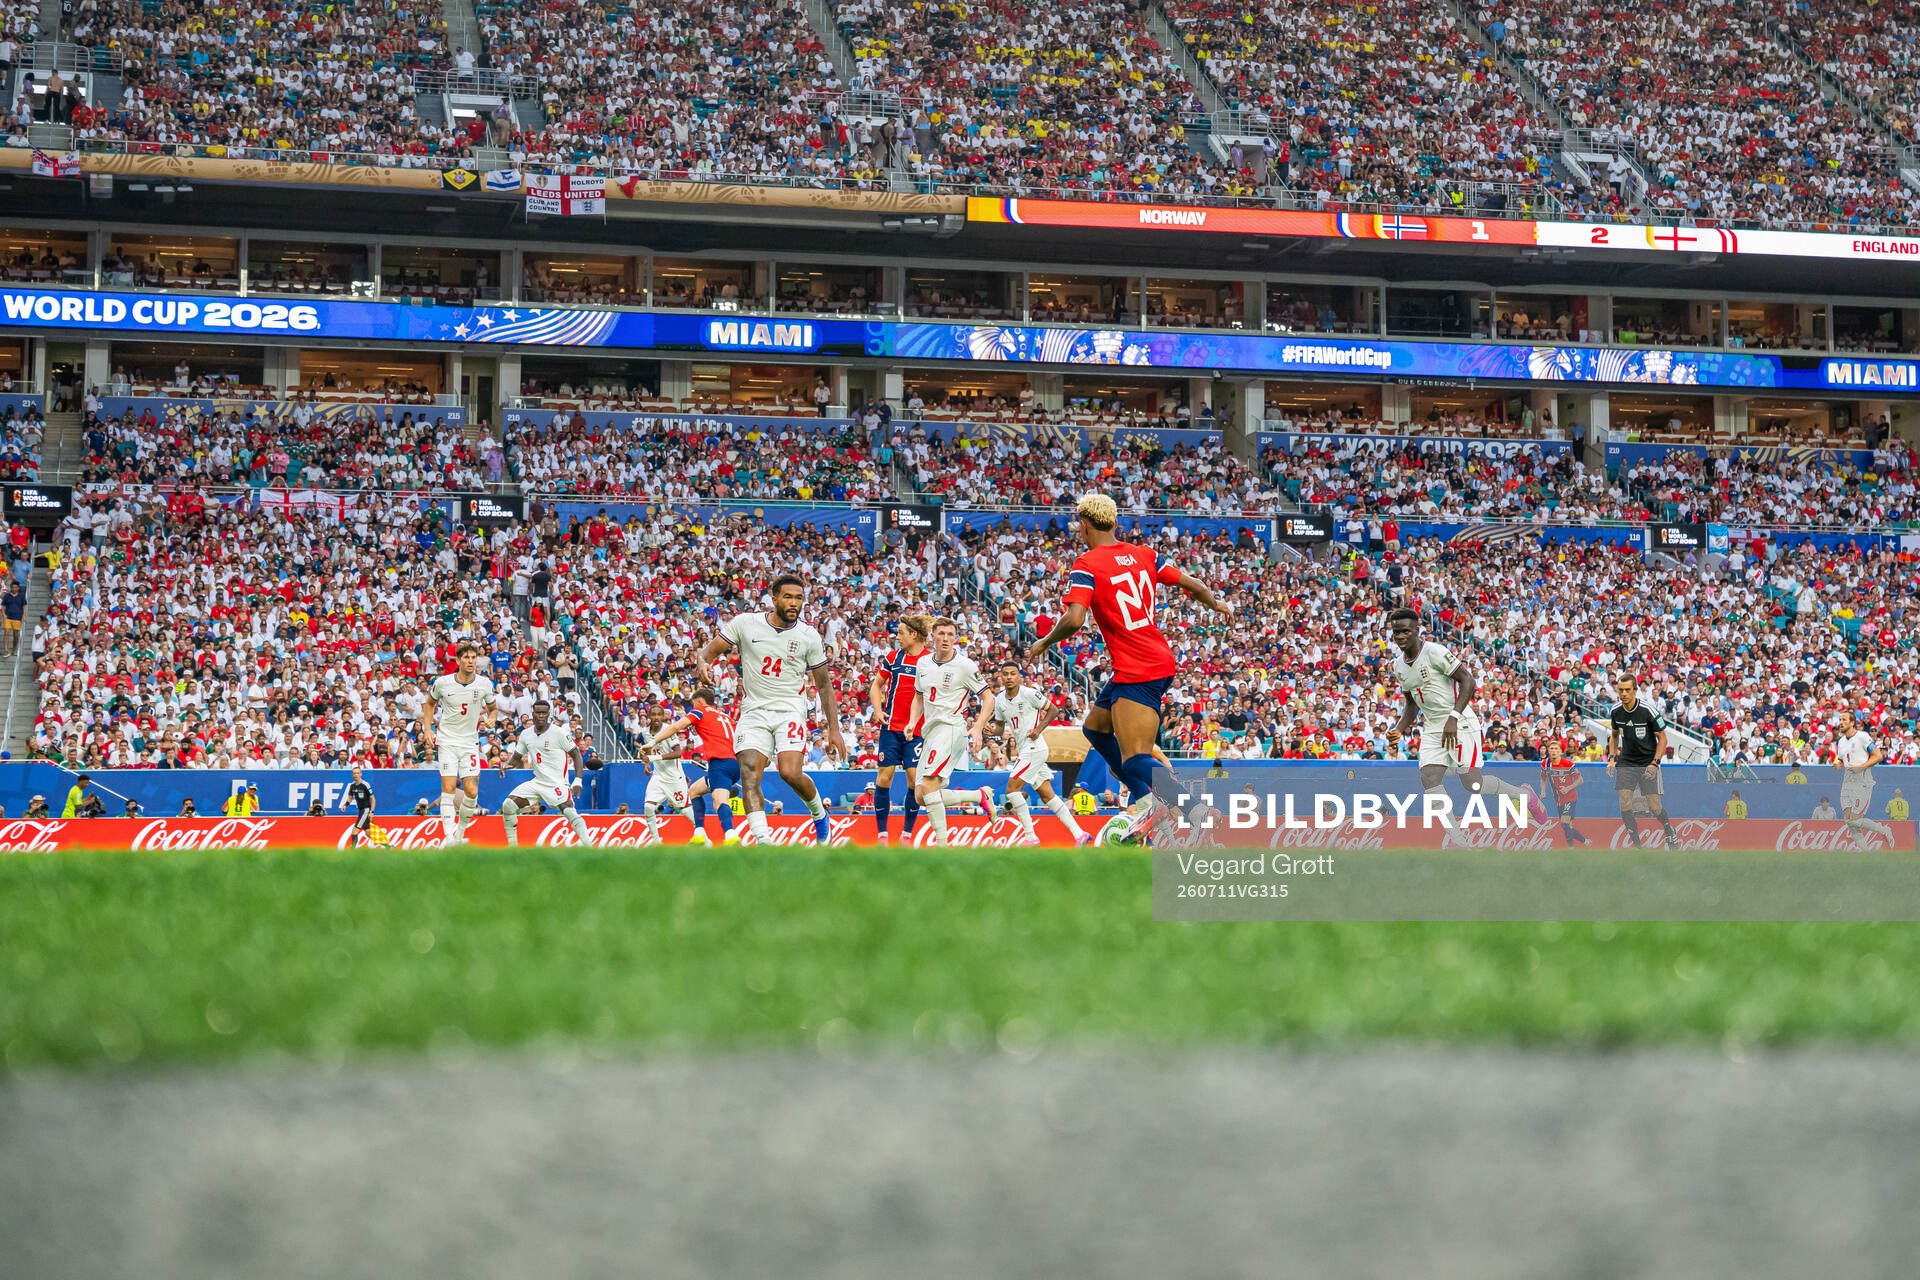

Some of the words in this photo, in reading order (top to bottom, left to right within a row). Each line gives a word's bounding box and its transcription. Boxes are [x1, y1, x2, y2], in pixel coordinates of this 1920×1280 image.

[530, 188, 561, 199] LEEDS
[564, 190, 601, 199] UNITED
[1139, 209, 1207, 226] NORWAY
[1472, 222, 1488, 240] 1
[1591, 227, 1609, 244] 2
[1853, 240, 1920, 254] ENGLAND
[3, 294, 126, 323] WORLD
[132, 301, 198, 325] CUP
[203, 303, 318, 330] 2026
[710, 321, 812, 347] MIAMI
[1282, 345, 1392, 369] #FIFAWorldCup
[1828, 362, 1916, 387] MIAMI
[761, 656, 783, 678] 24
[929, 687, 936, 702] 8
[461, 703, 468, 716] 5
[717, 714, 737, 745] 11
[787, 721, 804, 741] 24
[1010, 716, 1019, 730] 17
[470, 754, 477, 767] 5
[536, 752, 542, 764] 6
[927, 749, 937, 765] 8
[288, 782, 358, 809] FIFA
[554, 787, 562, 797] 6
[674, 791, 684, 801] 25
[131, 818, 277, 850] Coca-Cola
